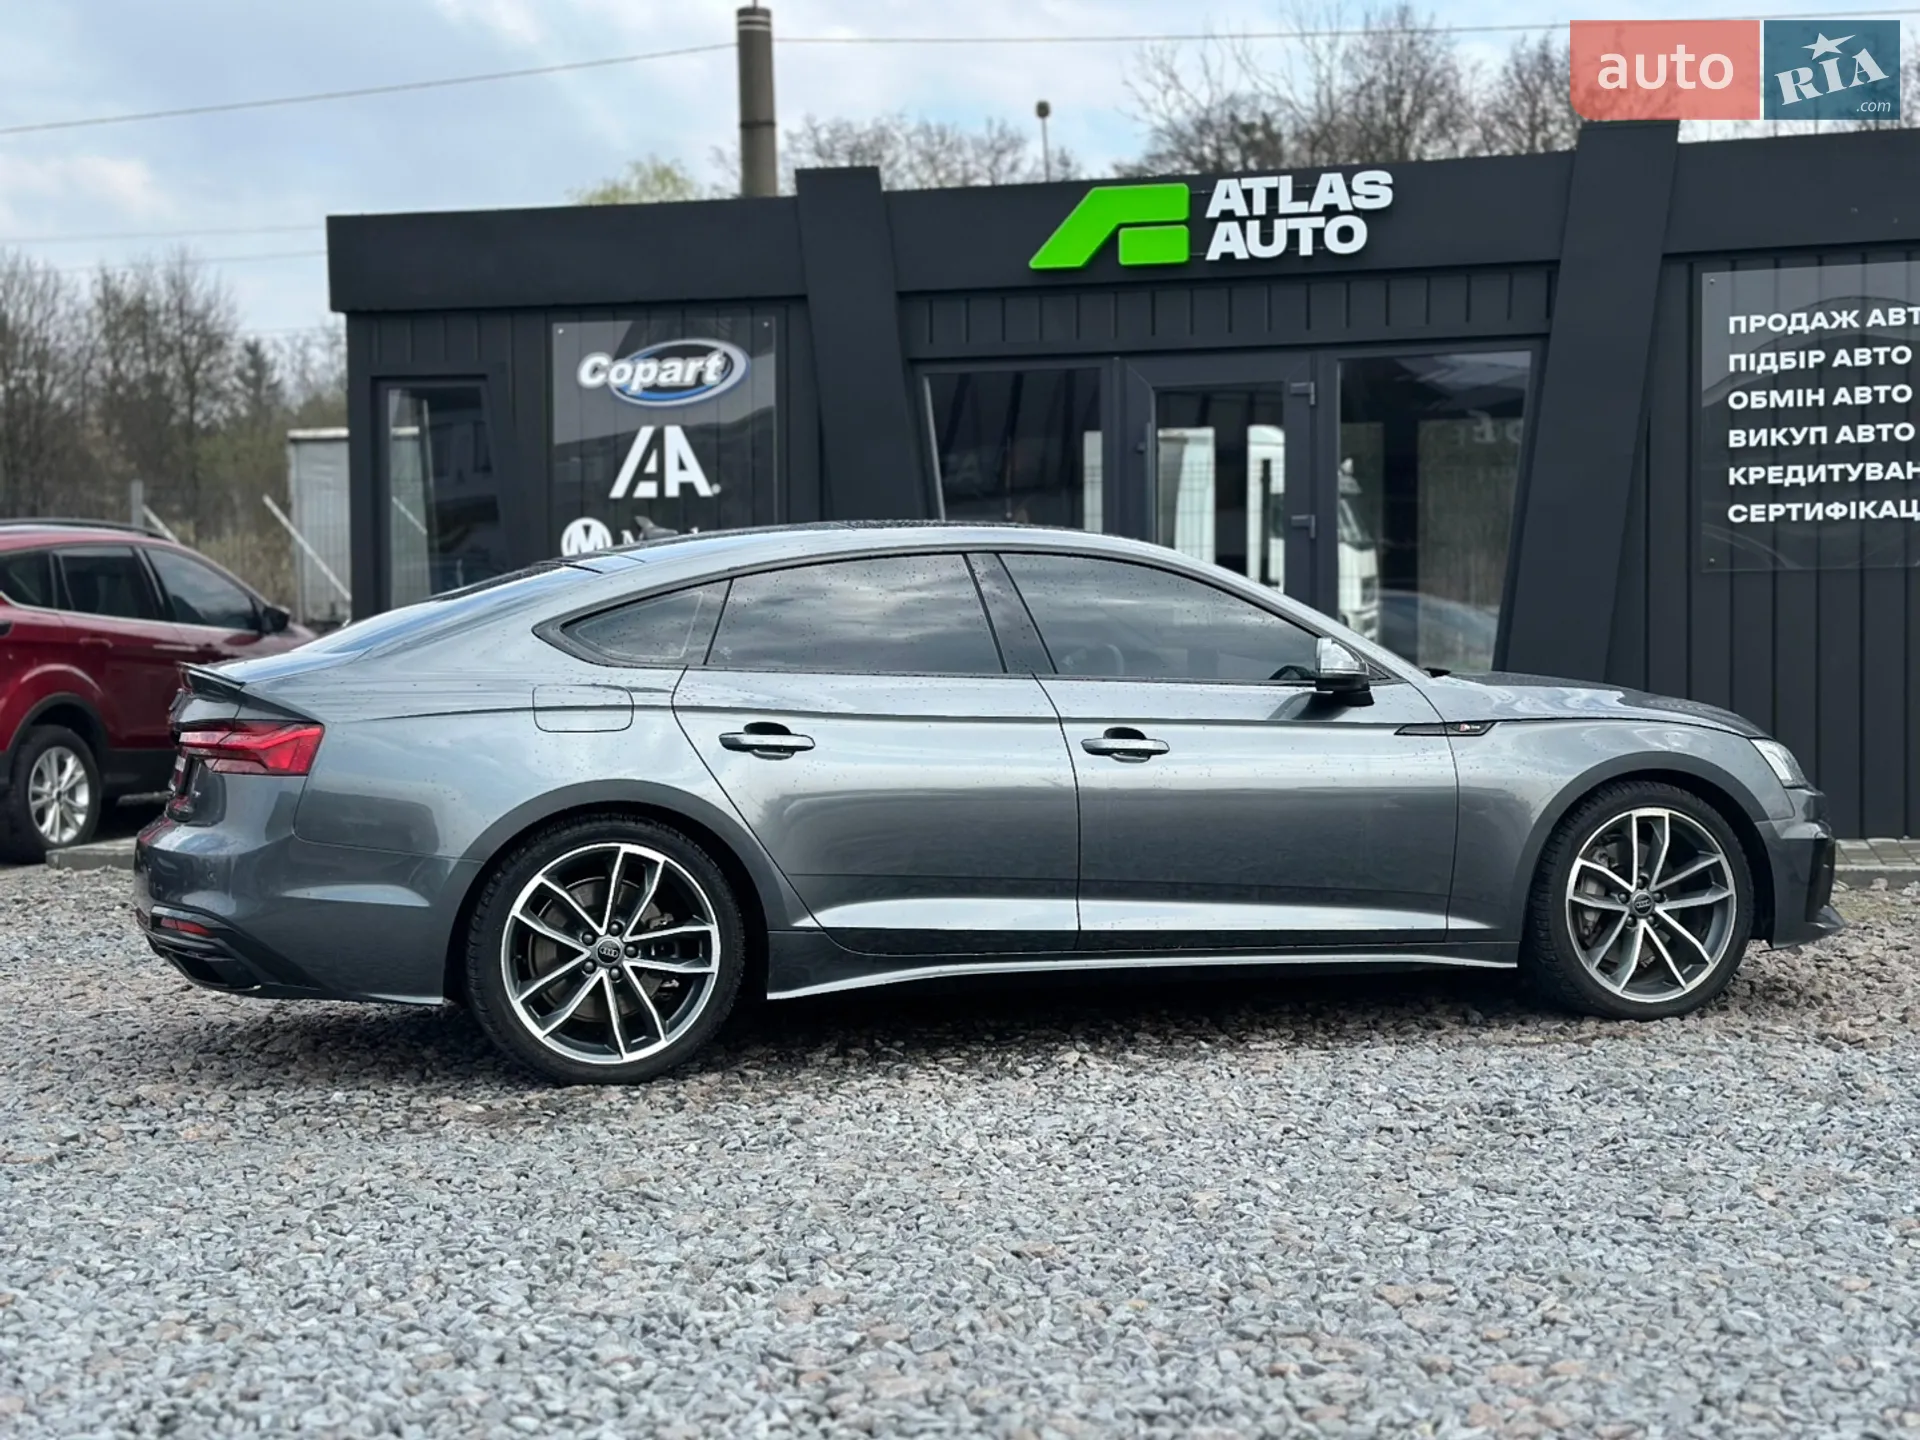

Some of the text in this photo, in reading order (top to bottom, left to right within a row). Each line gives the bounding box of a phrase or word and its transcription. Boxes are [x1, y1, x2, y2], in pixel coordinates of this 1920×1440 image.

[1205, 169, 1393, 219] ATLAS
[1205, 214, 1367, 261] AUTO
[1728, 309, 1860, 335] ПРОДАЖ
[577, 347, 726, 396] Copart
[1728, 345, 1912, 374] ПІДБІР АВТО
[1727, 384, 1913, 411] ОБМІН АВТО
[1728, 422, 1916, 448] ВИКУП АВТО
[1727, 498, 1920, 524] СЕРТИФІКАЦ
